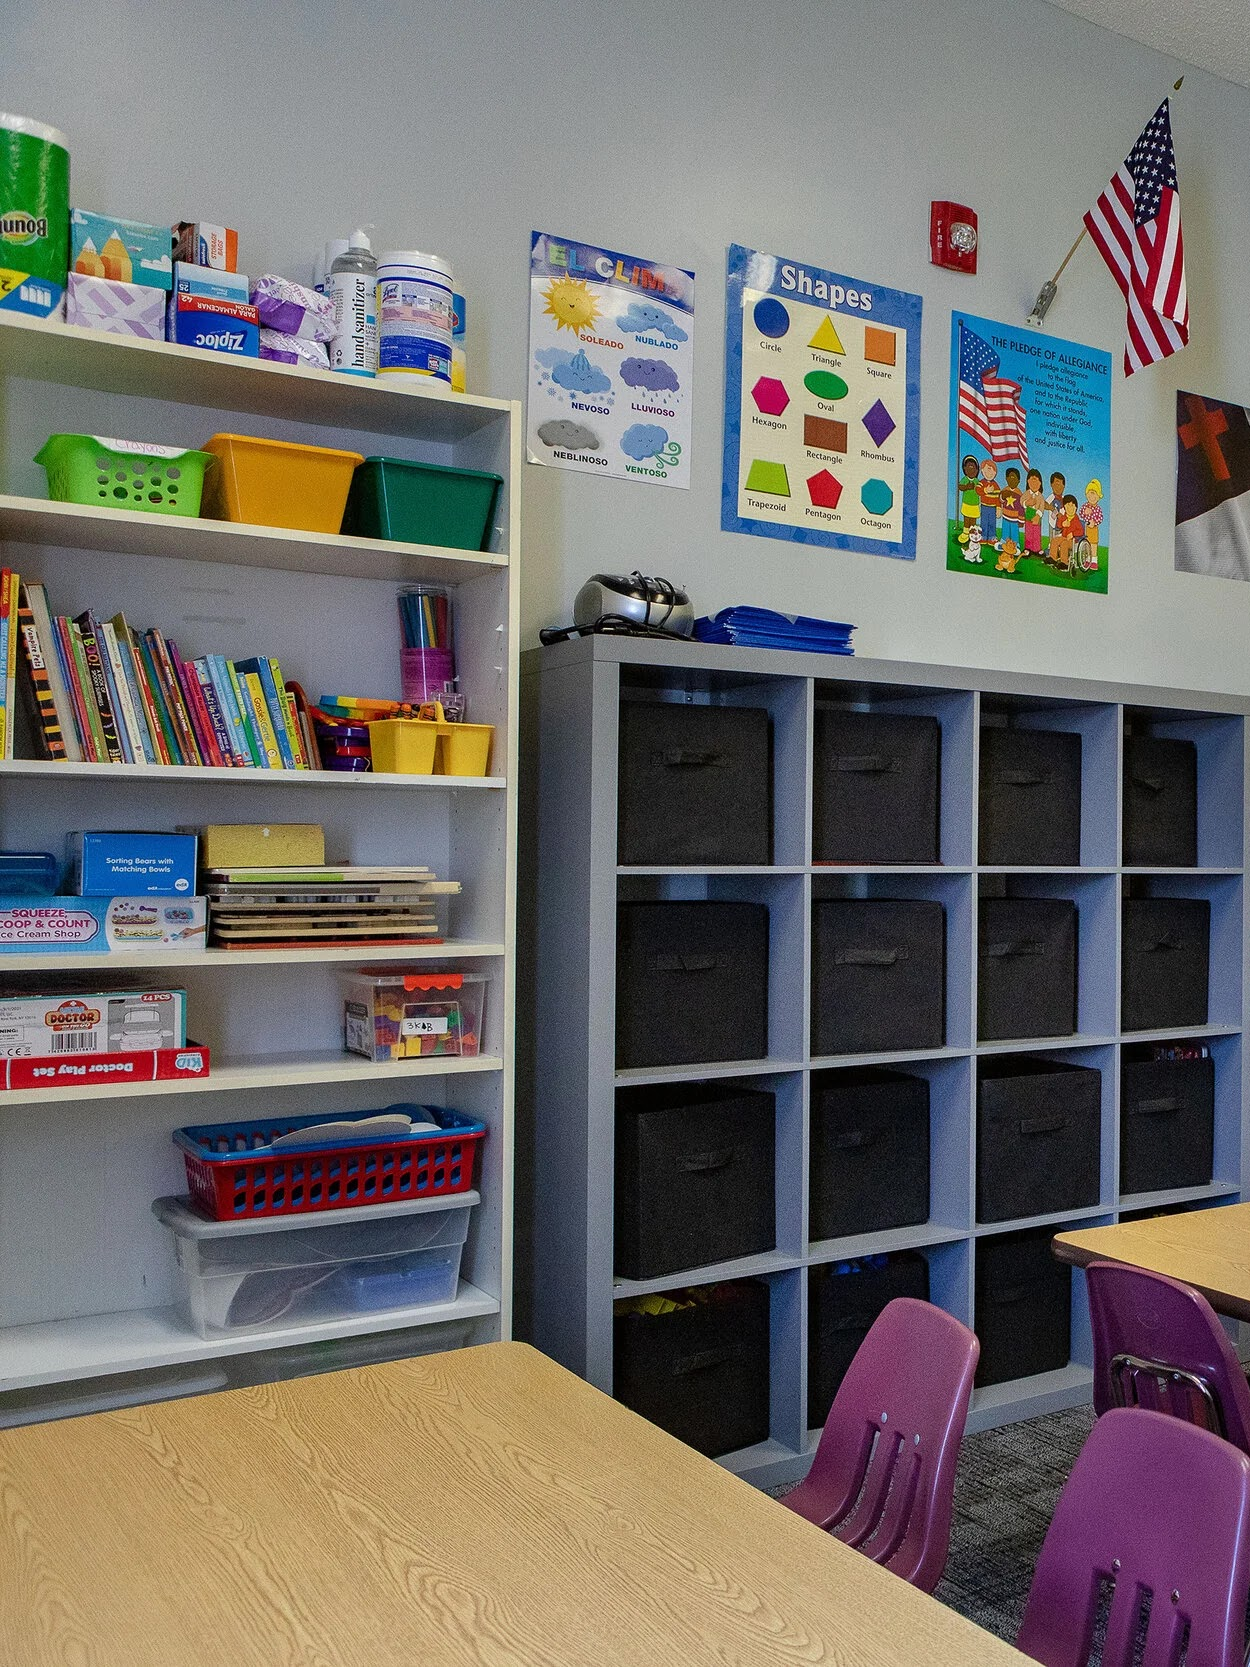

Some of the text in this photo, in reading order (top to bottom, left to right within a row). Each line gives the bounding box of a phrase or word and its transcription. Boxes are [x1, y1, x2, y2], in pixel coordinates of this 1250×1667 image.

[0, 218, 48, 237] Boun
[550, 244, 680, 299] EL CLIM
[179, 284, 189, 292] 25
[780, 264, 872, 312] Shapes
[197, 302, 256, 319] PARA ALMACENAR
[351, 278, 365, 368] hand sanitizer
[196, 331, 245, 351] Ziploc
[580, 334, 624, 350] SOLEADO
[635, 335, 678, 351] NUBLADO
[760, 340, 782, 353] Circle
[811, 353, 842, 368] Triangle
[991, 335, 1107, 375] THE PLEDGE OF ALLEGIANCE
[866, 367, 892, 380] Square
[1040, 361, 1059, 373] pledge
[1060, 367, 1089, 380] allegiance
[571, 401, 610, 415] NEVOSO
[631, 403, 675, 418] LLUVIOSO
[817, 401, 835, 413] Oval
[1030, 407, 1041, 415] one
[1042, 409, 1060, 419] nation
[1062, 412, 1078, 423] under
[752, 416, 787, 431] Hexagon
[553, 450, 608, 466] NEBLINOSO
[806, 450, 843, 465] Rectangle
[860, 449, 895, 463] Rhombus
[625, 465, 667, 479] VENTOSO
[747, 498, 787, 512] Trapezoid
[805, 508, 842, 523] Pentagon
[860, 517, 892, 530] Octagon
[27, 627, 39, 654] Vampire
[84, 638, 100, 667] BOO!
[253, 696, 267, 718] Gossie
[111, 866, 147, 874] Matching
[11, 909, 68, 918] SQUEEZE,
[35, 920, 44, 928] &
[48, 919, 91, 928] COUNT
[54, 930, 81, 938] Shop
[153, 993, 171, 1001] PCS
[50, 1013, 95, 1023] DOCTOR
[32, 1063, 134, 1077] Doctor Play Set
